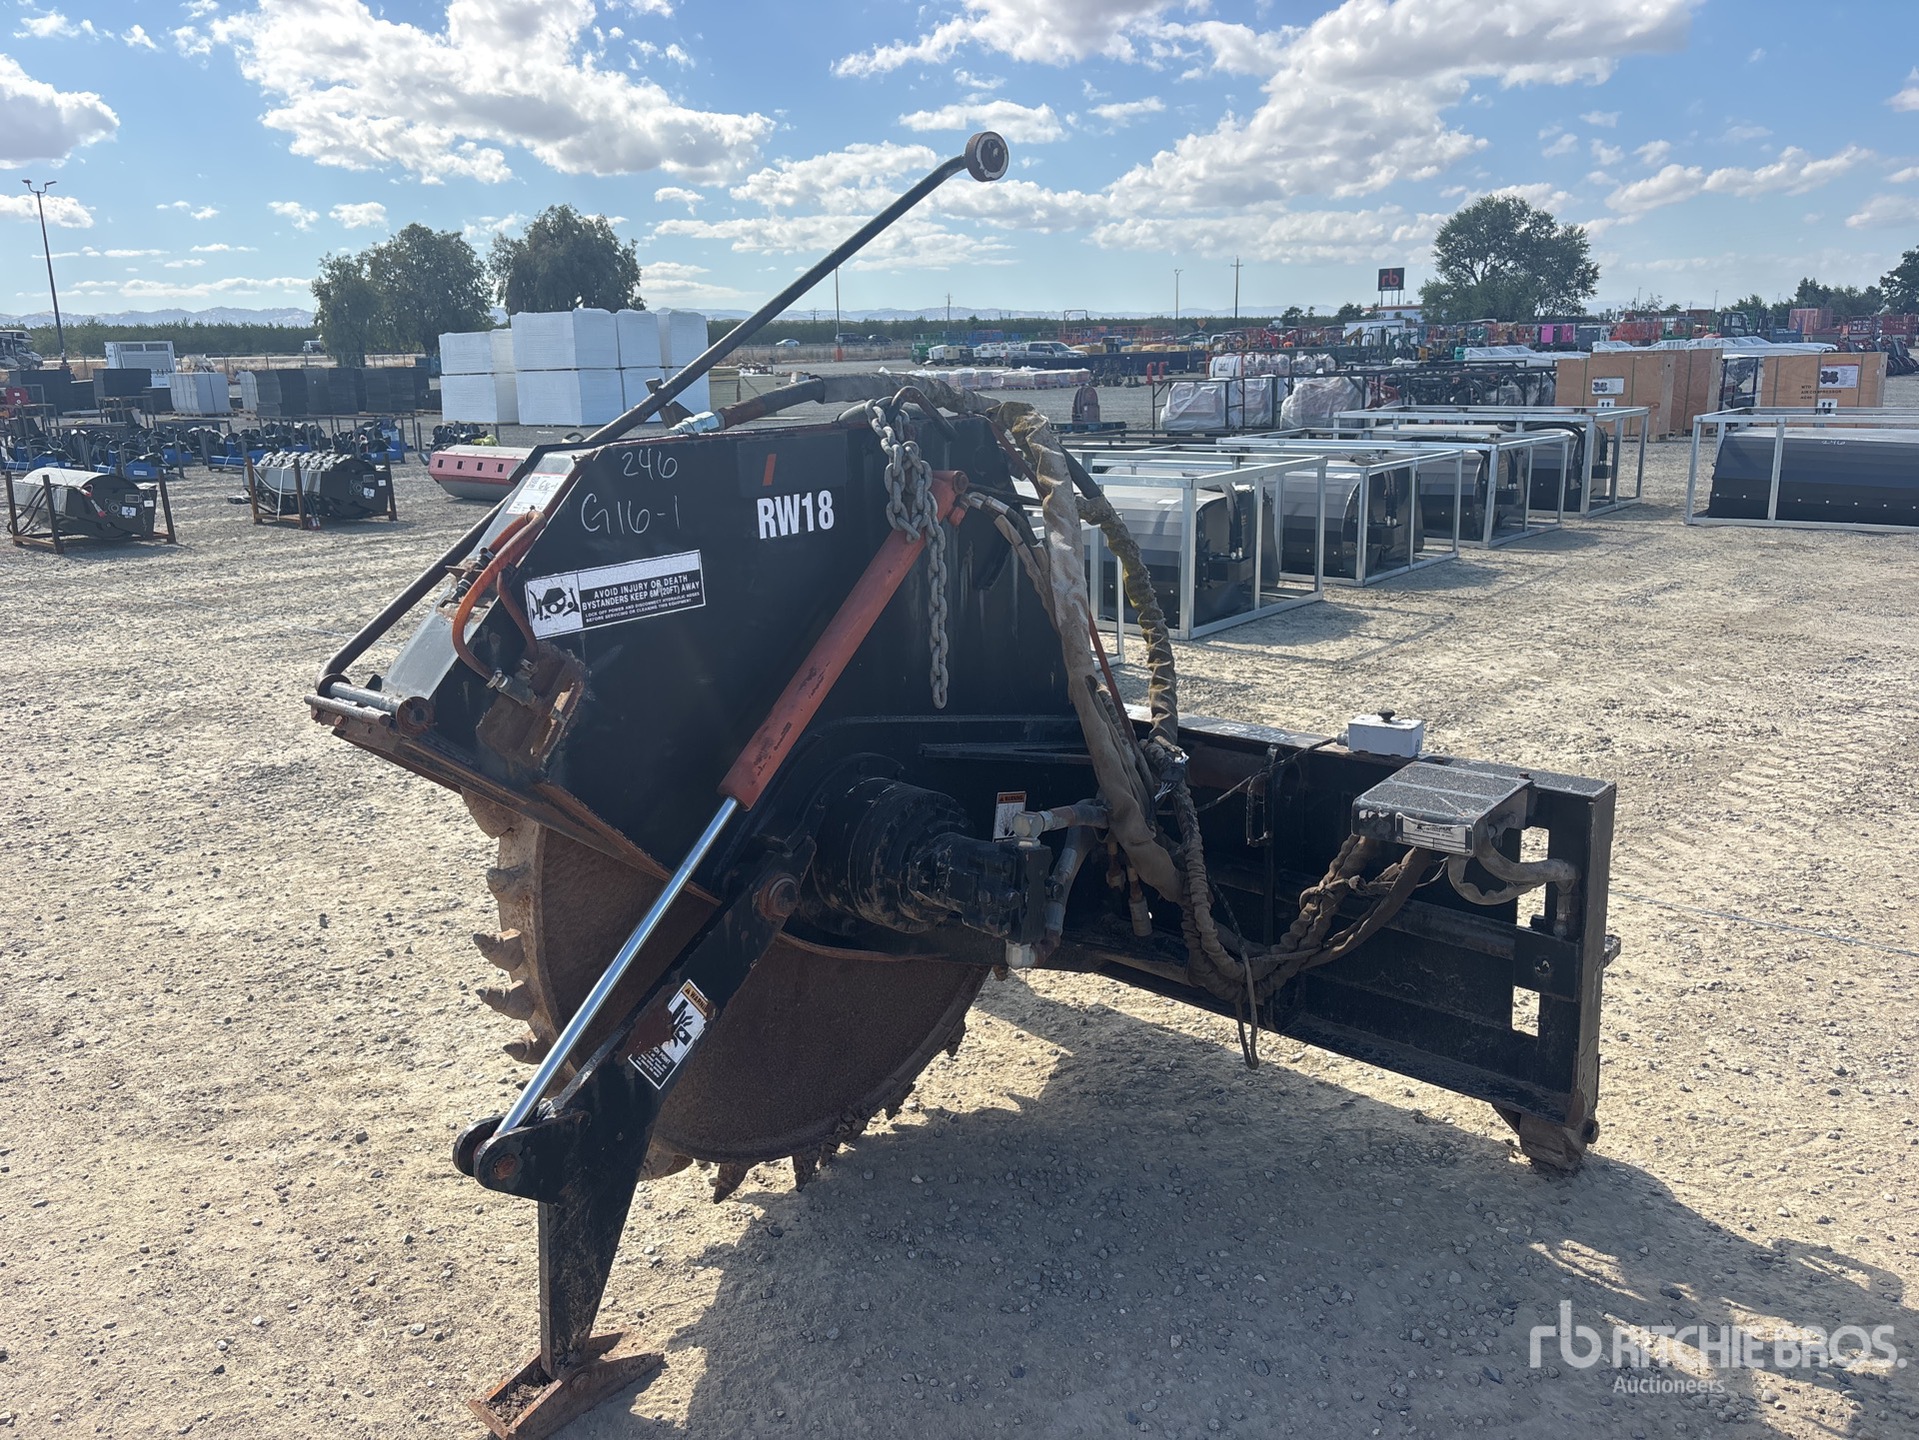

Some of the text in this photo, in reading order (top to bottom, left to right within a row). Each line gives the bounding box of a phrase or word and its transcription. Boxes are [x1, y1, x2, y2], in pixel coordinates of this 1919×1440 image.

[622, 448, 678, 480] 246
[581, 493, 680, 535] G16-1
[757, 490, 835, 540] RW18
[582, 581, 700, 610] BYSTANDERS KEEP 6M (20FT) AWAY
[594, 575, 688, 599] AVOID INJURY OR DEATH
[635, 599, 662, 608] DISCONNECT
[689, 991, 710, 1012] WARNI
